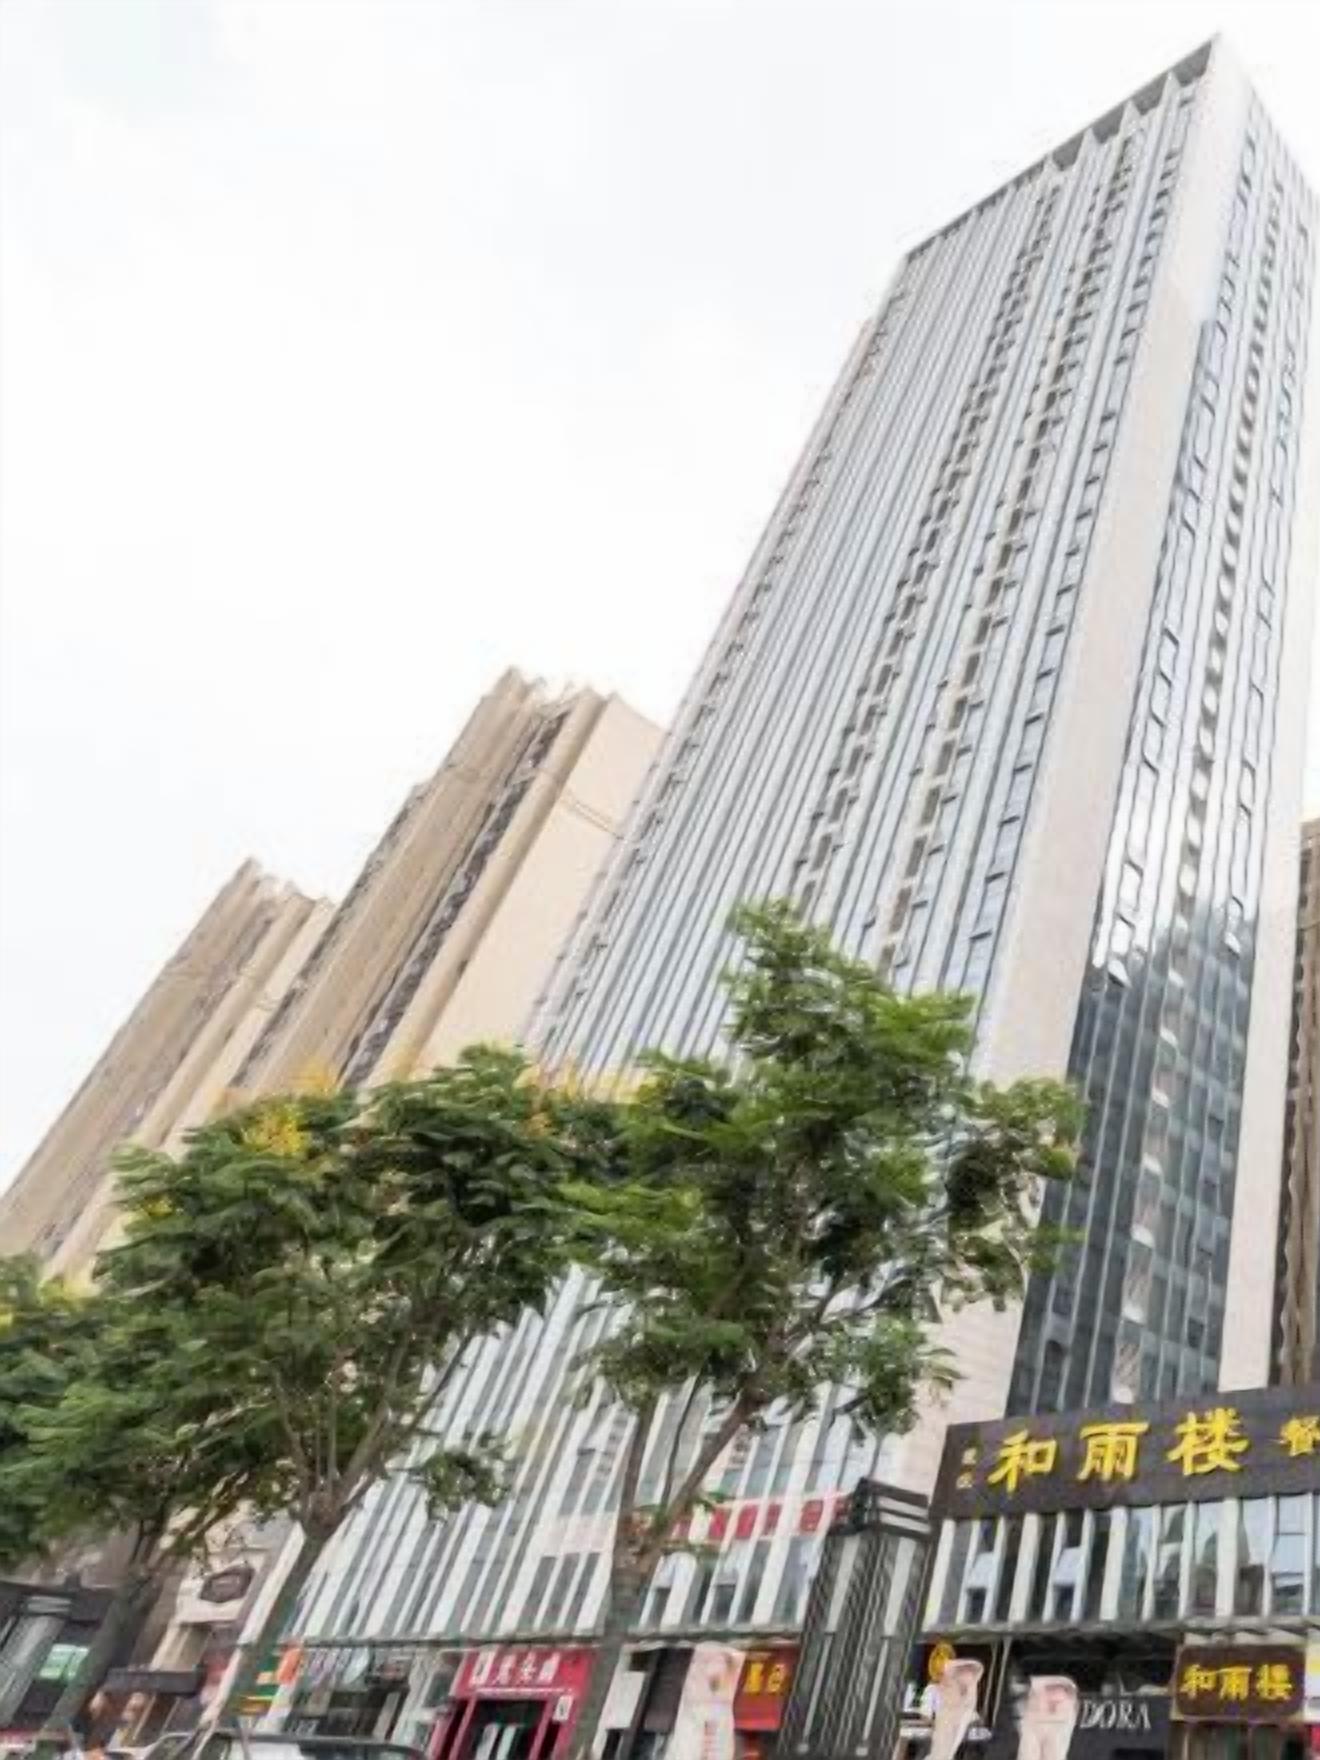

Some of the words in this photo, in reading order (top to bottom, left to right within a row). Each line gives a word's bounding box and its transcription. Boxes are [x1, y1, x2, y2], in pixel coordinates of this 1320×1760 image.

[987, 1408, 1249, 1494] 和雨楼
[1180, 1664, 1293, 1700] 和雨楼
